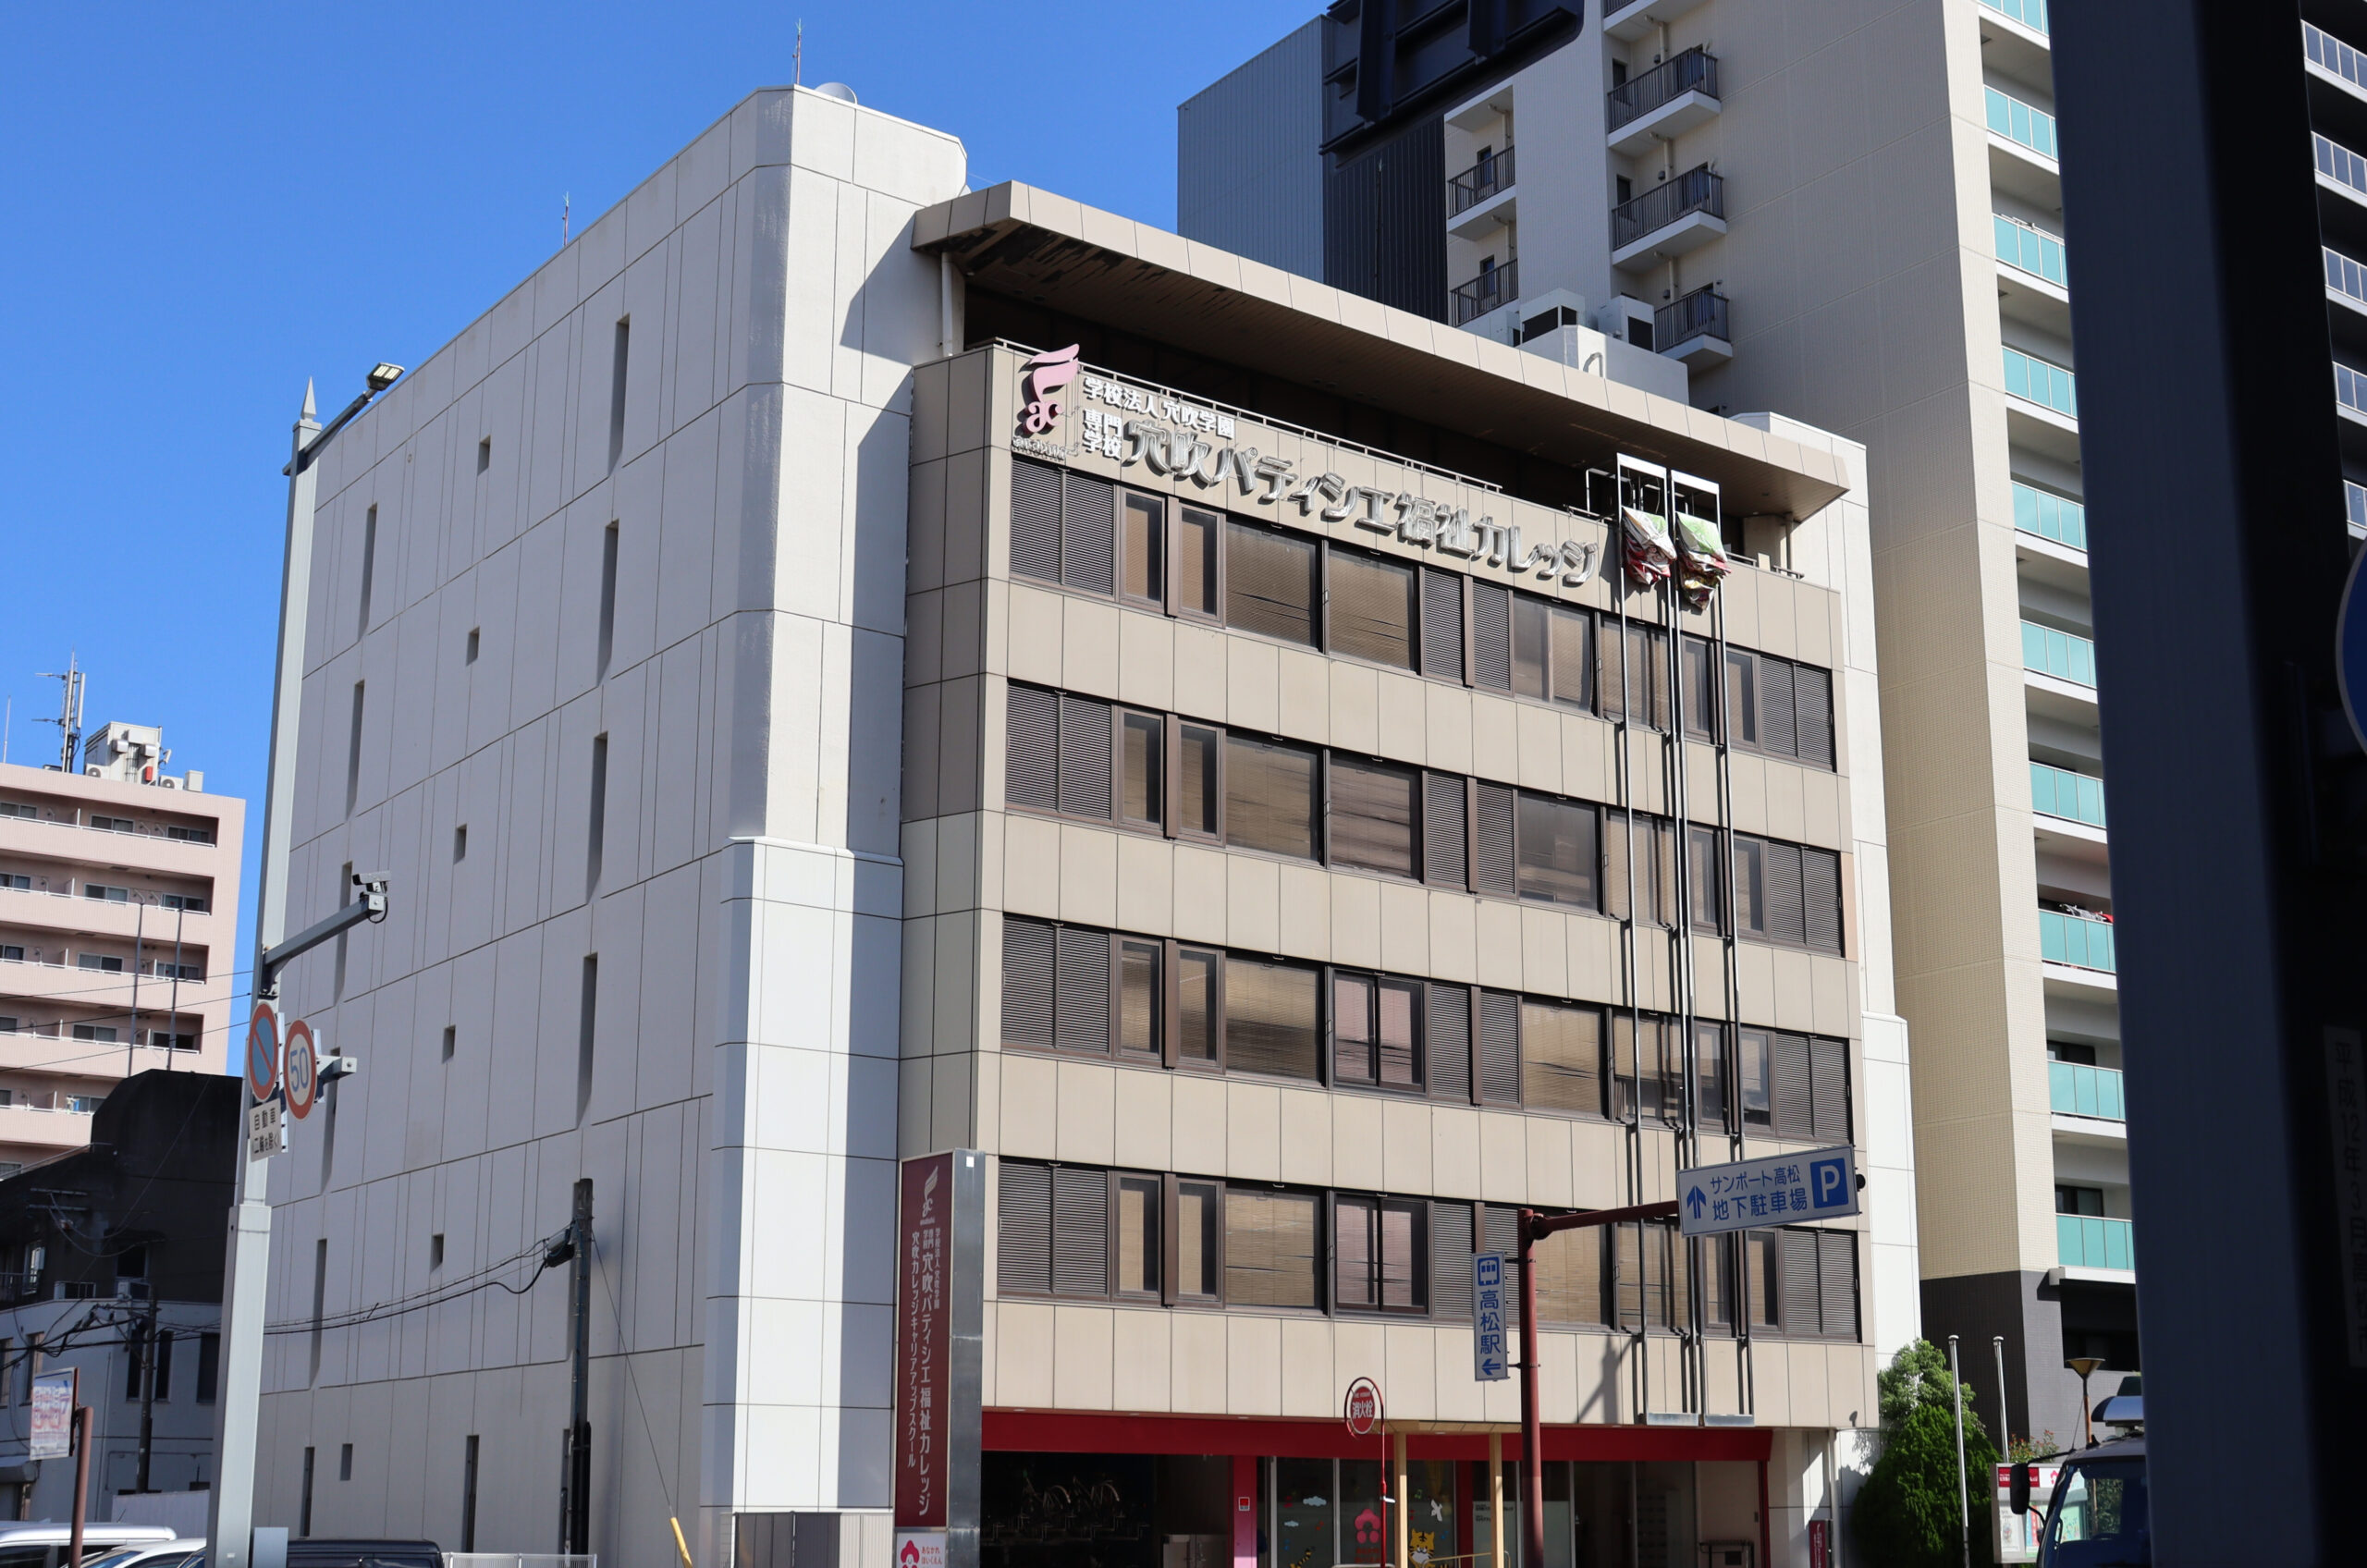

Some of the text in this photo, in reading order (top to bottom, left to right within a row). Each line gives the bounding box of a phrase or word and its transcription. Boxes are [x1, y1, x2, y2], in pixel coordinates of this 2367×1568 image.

[1084, 409, 1122, 437] 専門
[1084, 429, 1122, 459] 学校
[1123, 418, 1599, 584] 穴吹パティシエ福祉カレッジ
[289, 1047, 309, 1093] 50
[1710, 1164, 1801, 1195] サンポート高松
[1819, 1164, 1841, 1203] P
[1712, 1188, 1808, 1222] 地下駐車場
[1479, 1291, 1501, 1354] 高松駅
[1353, 1400, 1374, 1420] 消火栓
